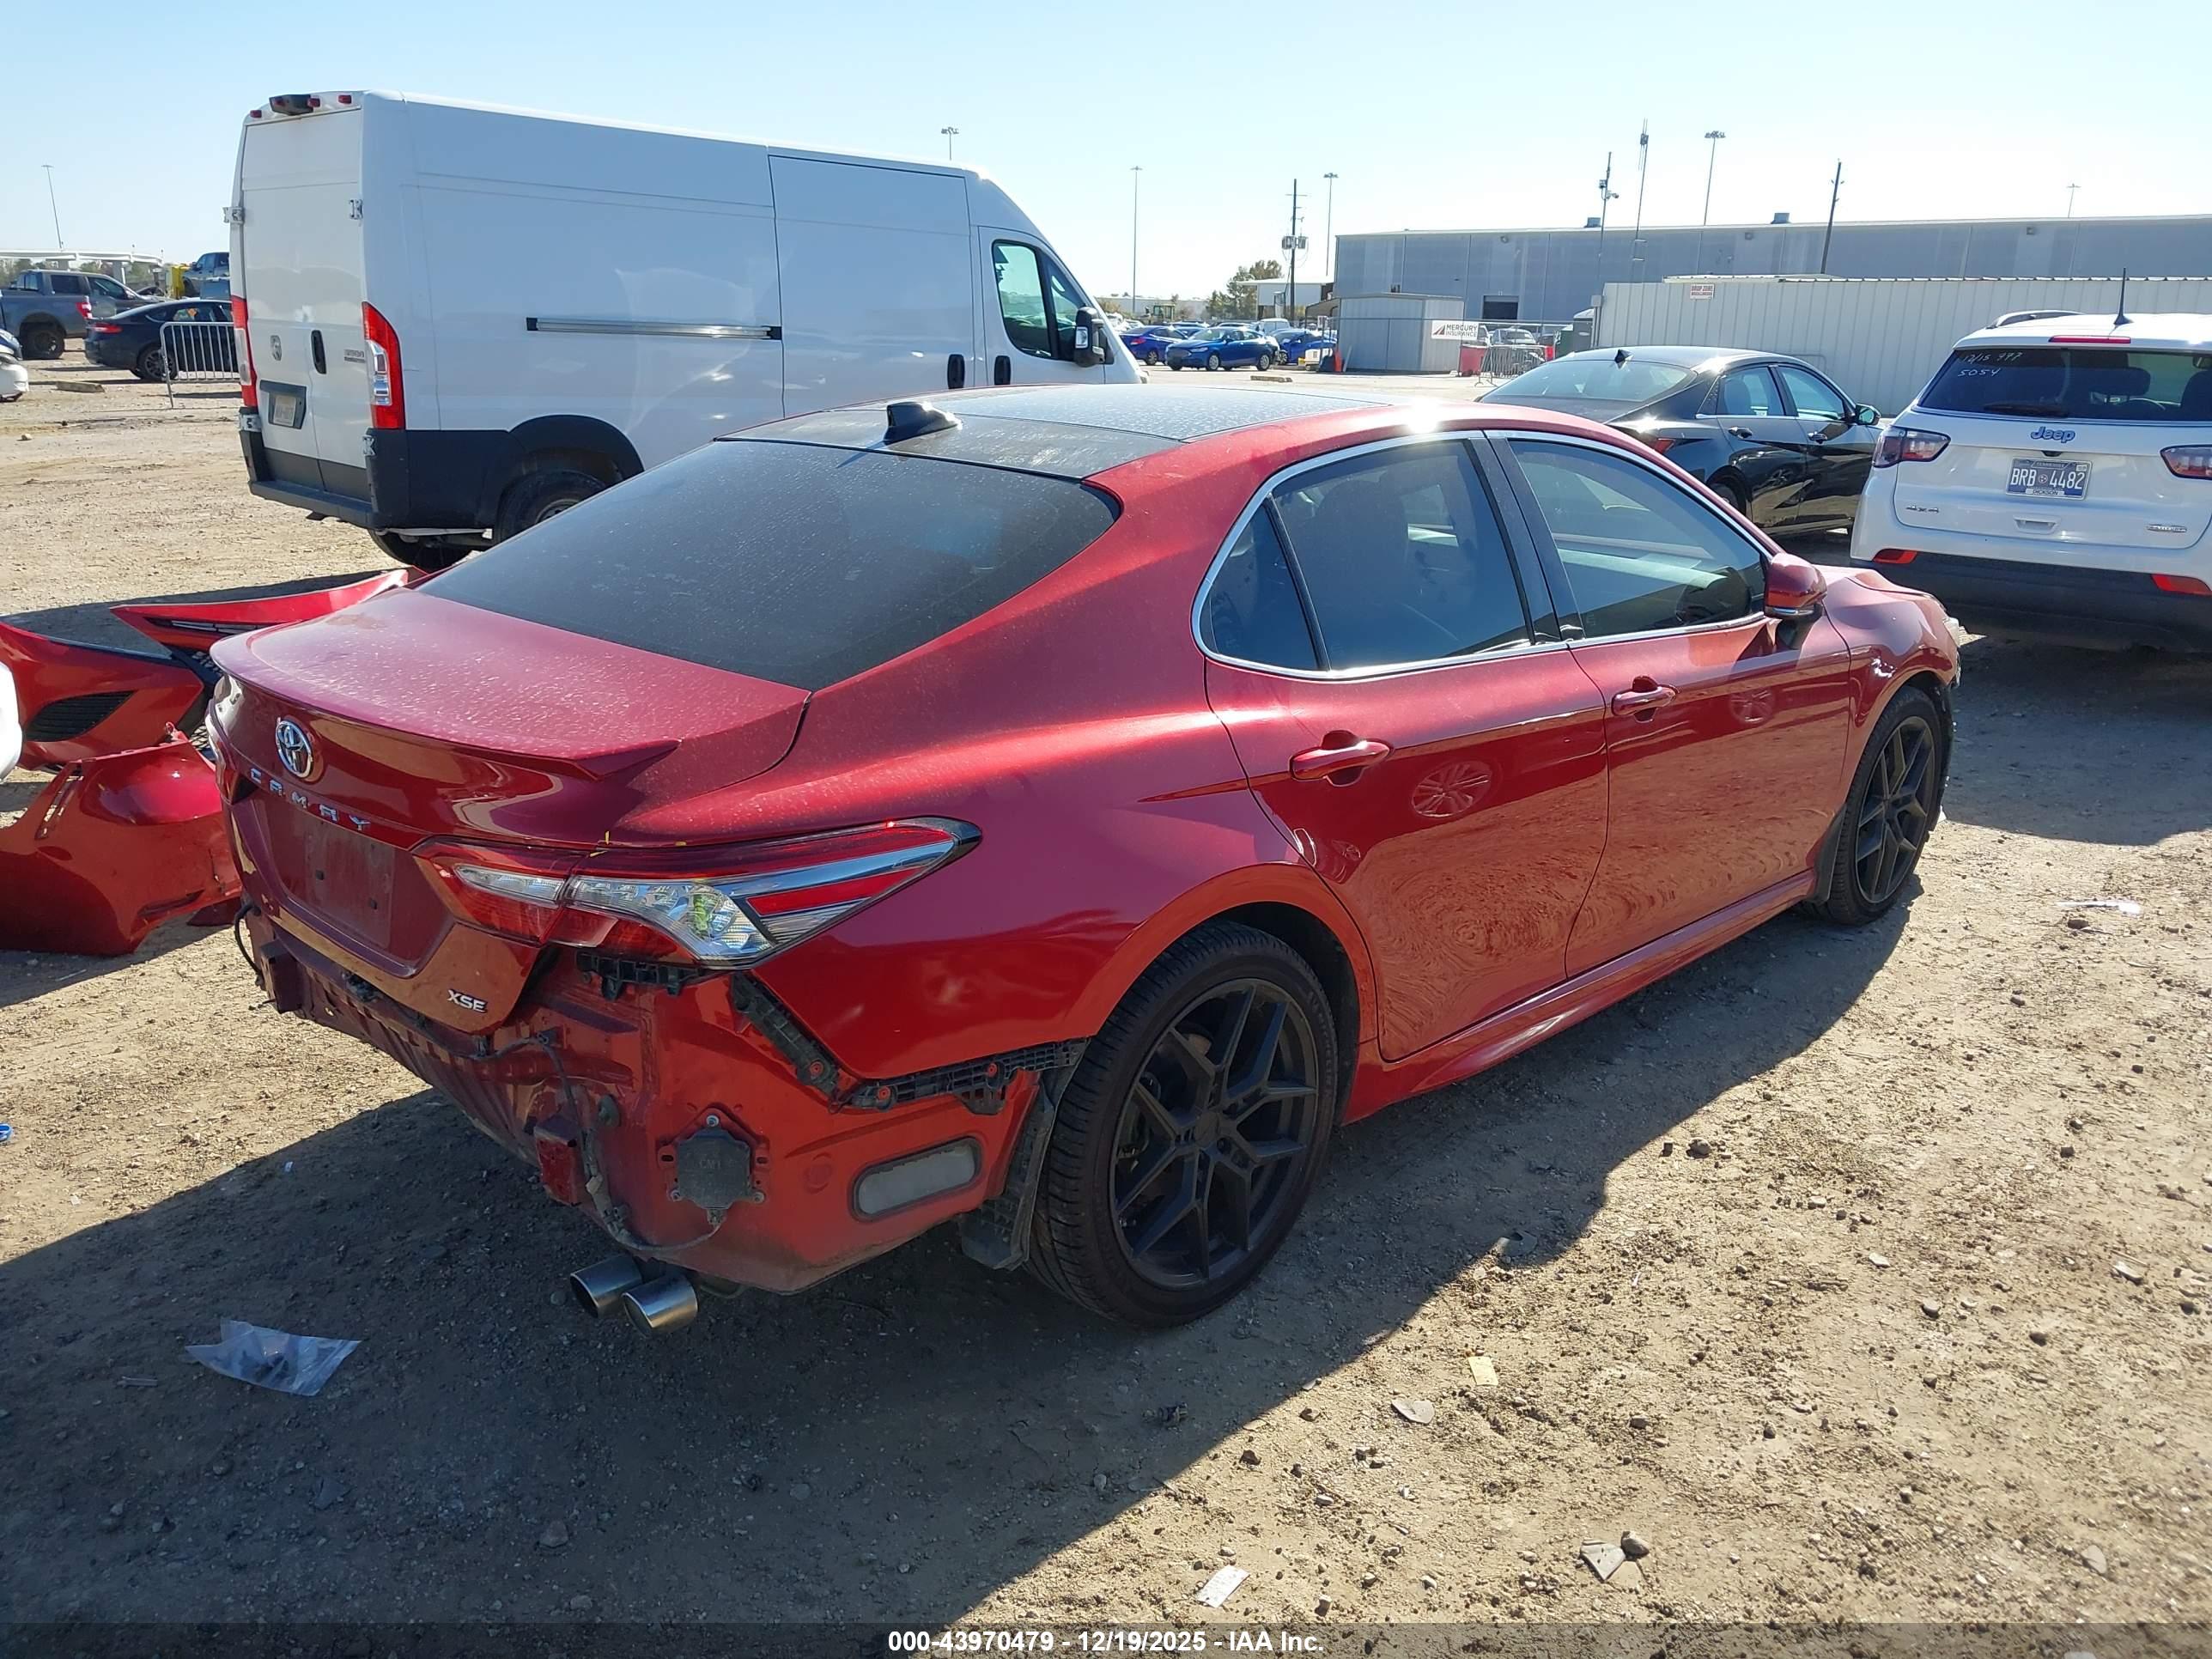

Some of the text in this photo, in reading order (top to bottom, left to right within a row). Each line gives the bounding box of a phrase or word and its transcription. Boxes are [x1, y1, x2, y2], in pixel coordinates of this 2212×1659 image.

[2031, 426, 2076, 444] Jeep
[2010, 468, 2085, 489] BRB 4482
[250, 768, 371, 831] CAMRY
[447, 988, 488, 1013] XSE
